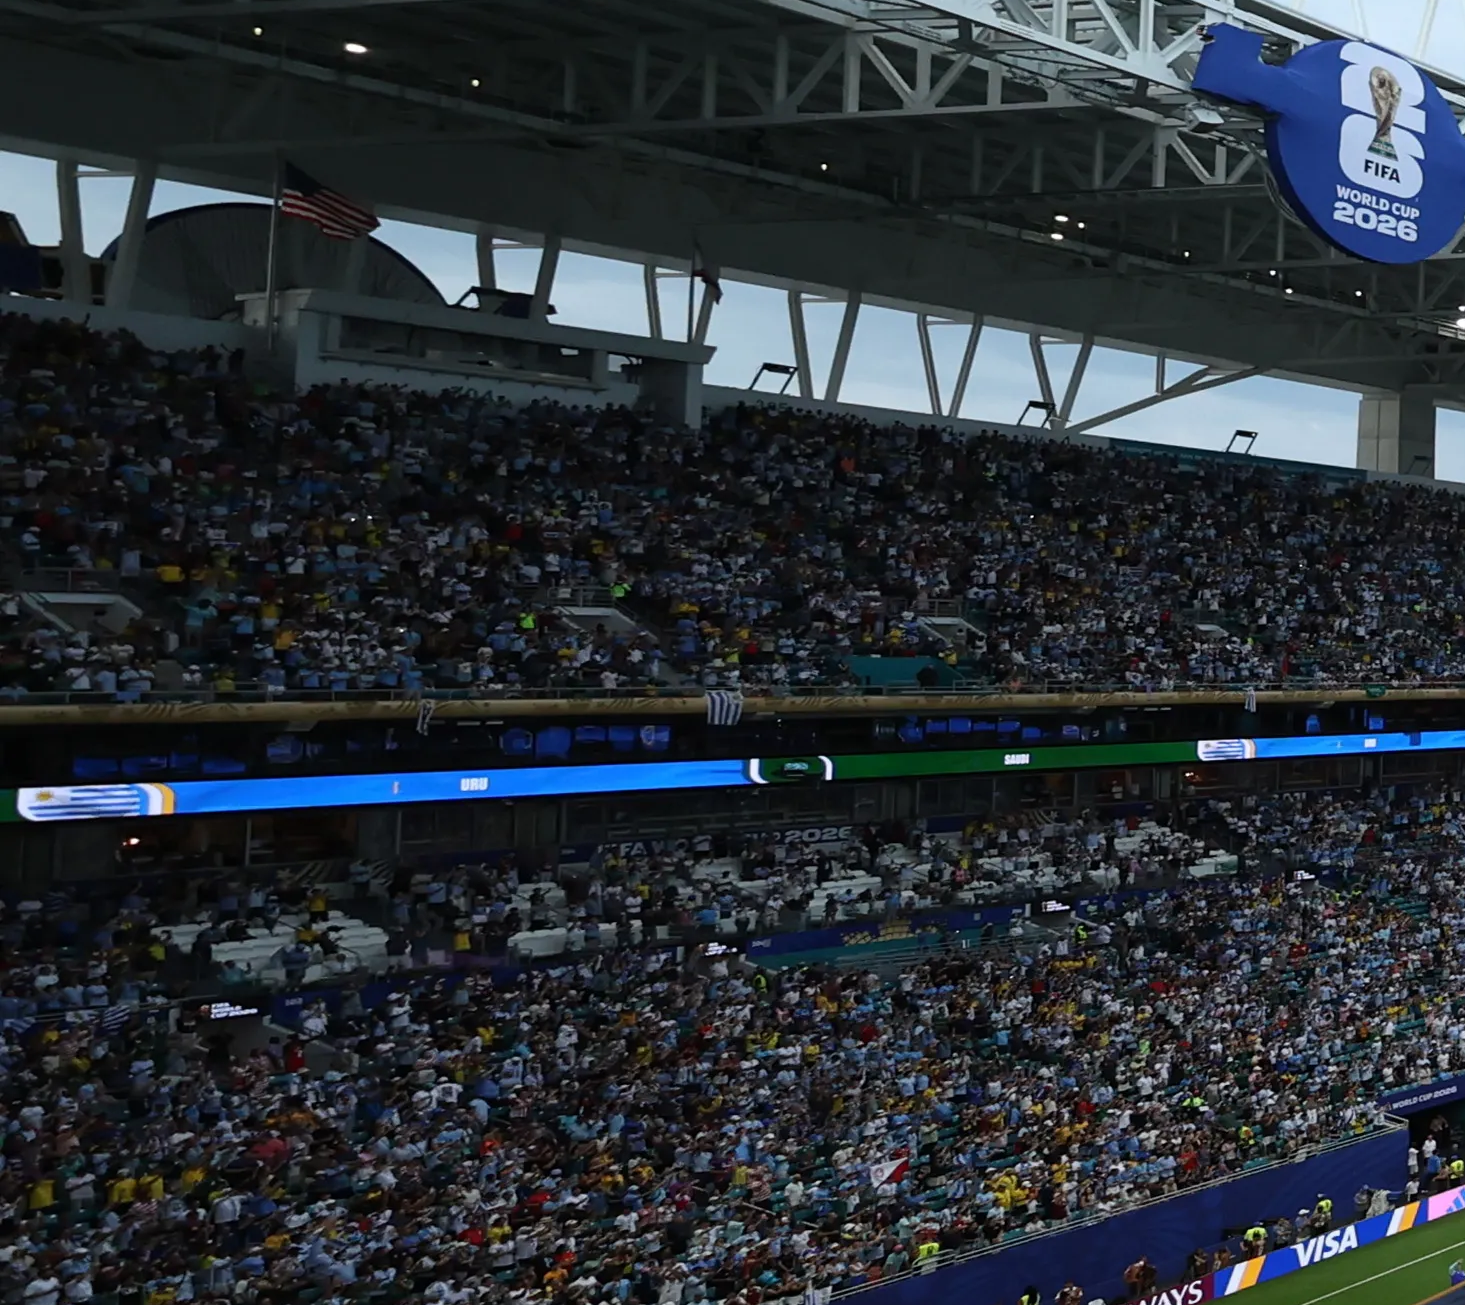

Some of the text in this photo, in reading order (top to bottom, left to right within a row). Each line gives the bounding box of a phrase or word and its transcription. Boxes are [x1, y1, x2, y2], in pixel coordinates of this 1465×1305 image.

[1364, 159, 1401, 184] FIFA
[1336, 184, 1420, 220] WORLD CUP
[1333, 201, 1419, 242] 2026
[460, 777, 489, 792] URU
[1392, 1086, 1458, 1109] WORLD CUP 2026
[1290, 1224, 1360, 1268] VISA
